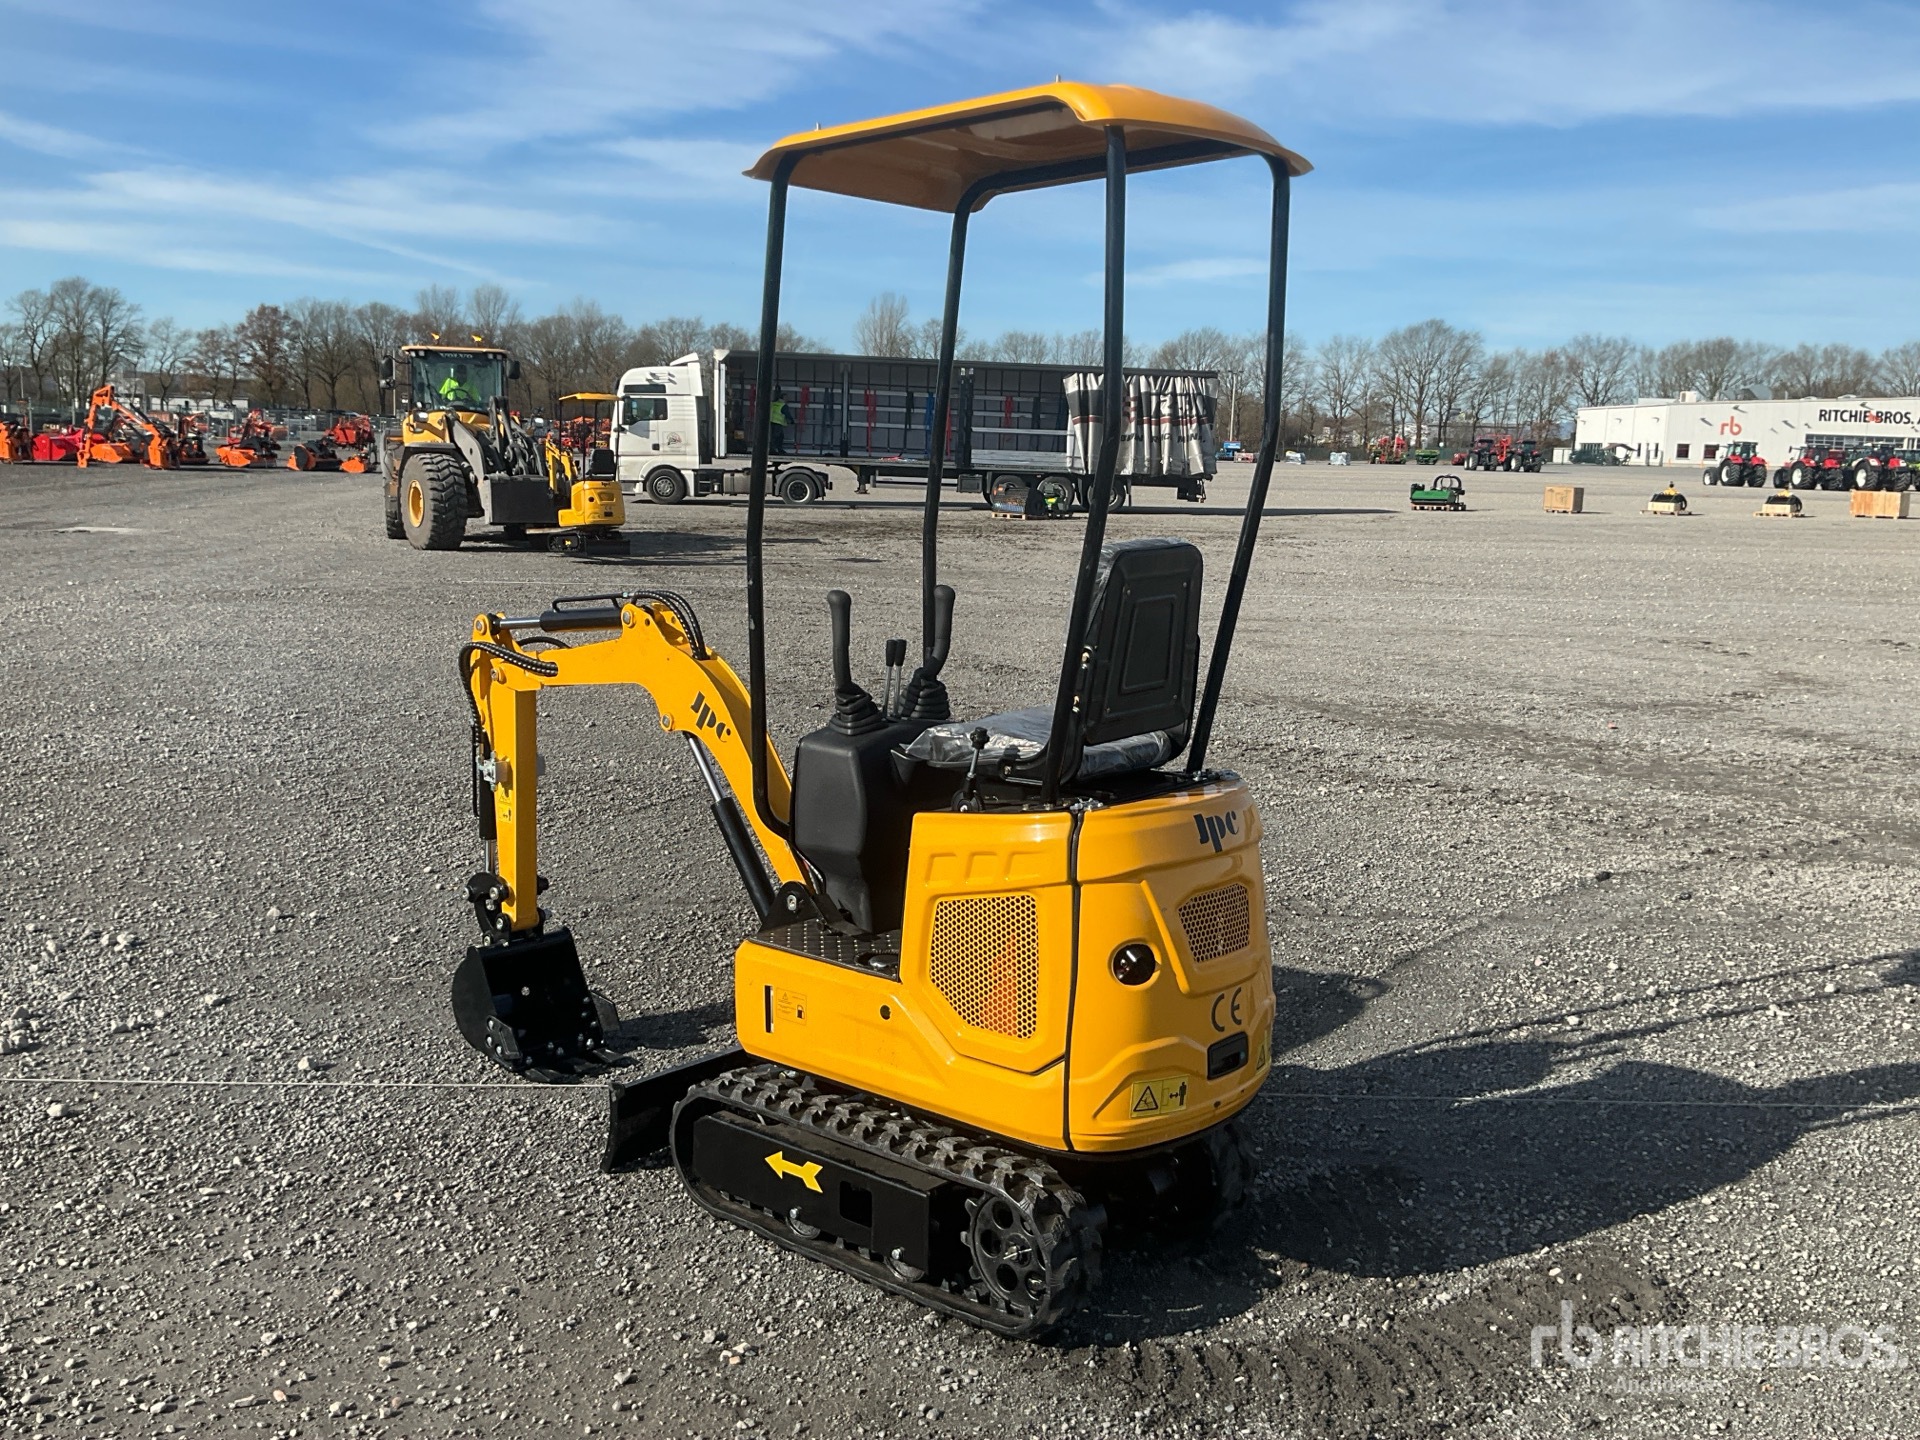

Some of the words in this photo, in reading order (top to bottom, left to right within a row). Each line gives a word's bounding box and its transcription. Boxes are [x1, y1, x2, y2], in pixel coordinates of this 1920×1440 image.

[1720, 415, 1742, 436] rb
[1818, 409, 1870, 423] RITCHIE
[1875, 411, 1914, 424] BROS.
[1211, 987, 1242, 1032] CE
